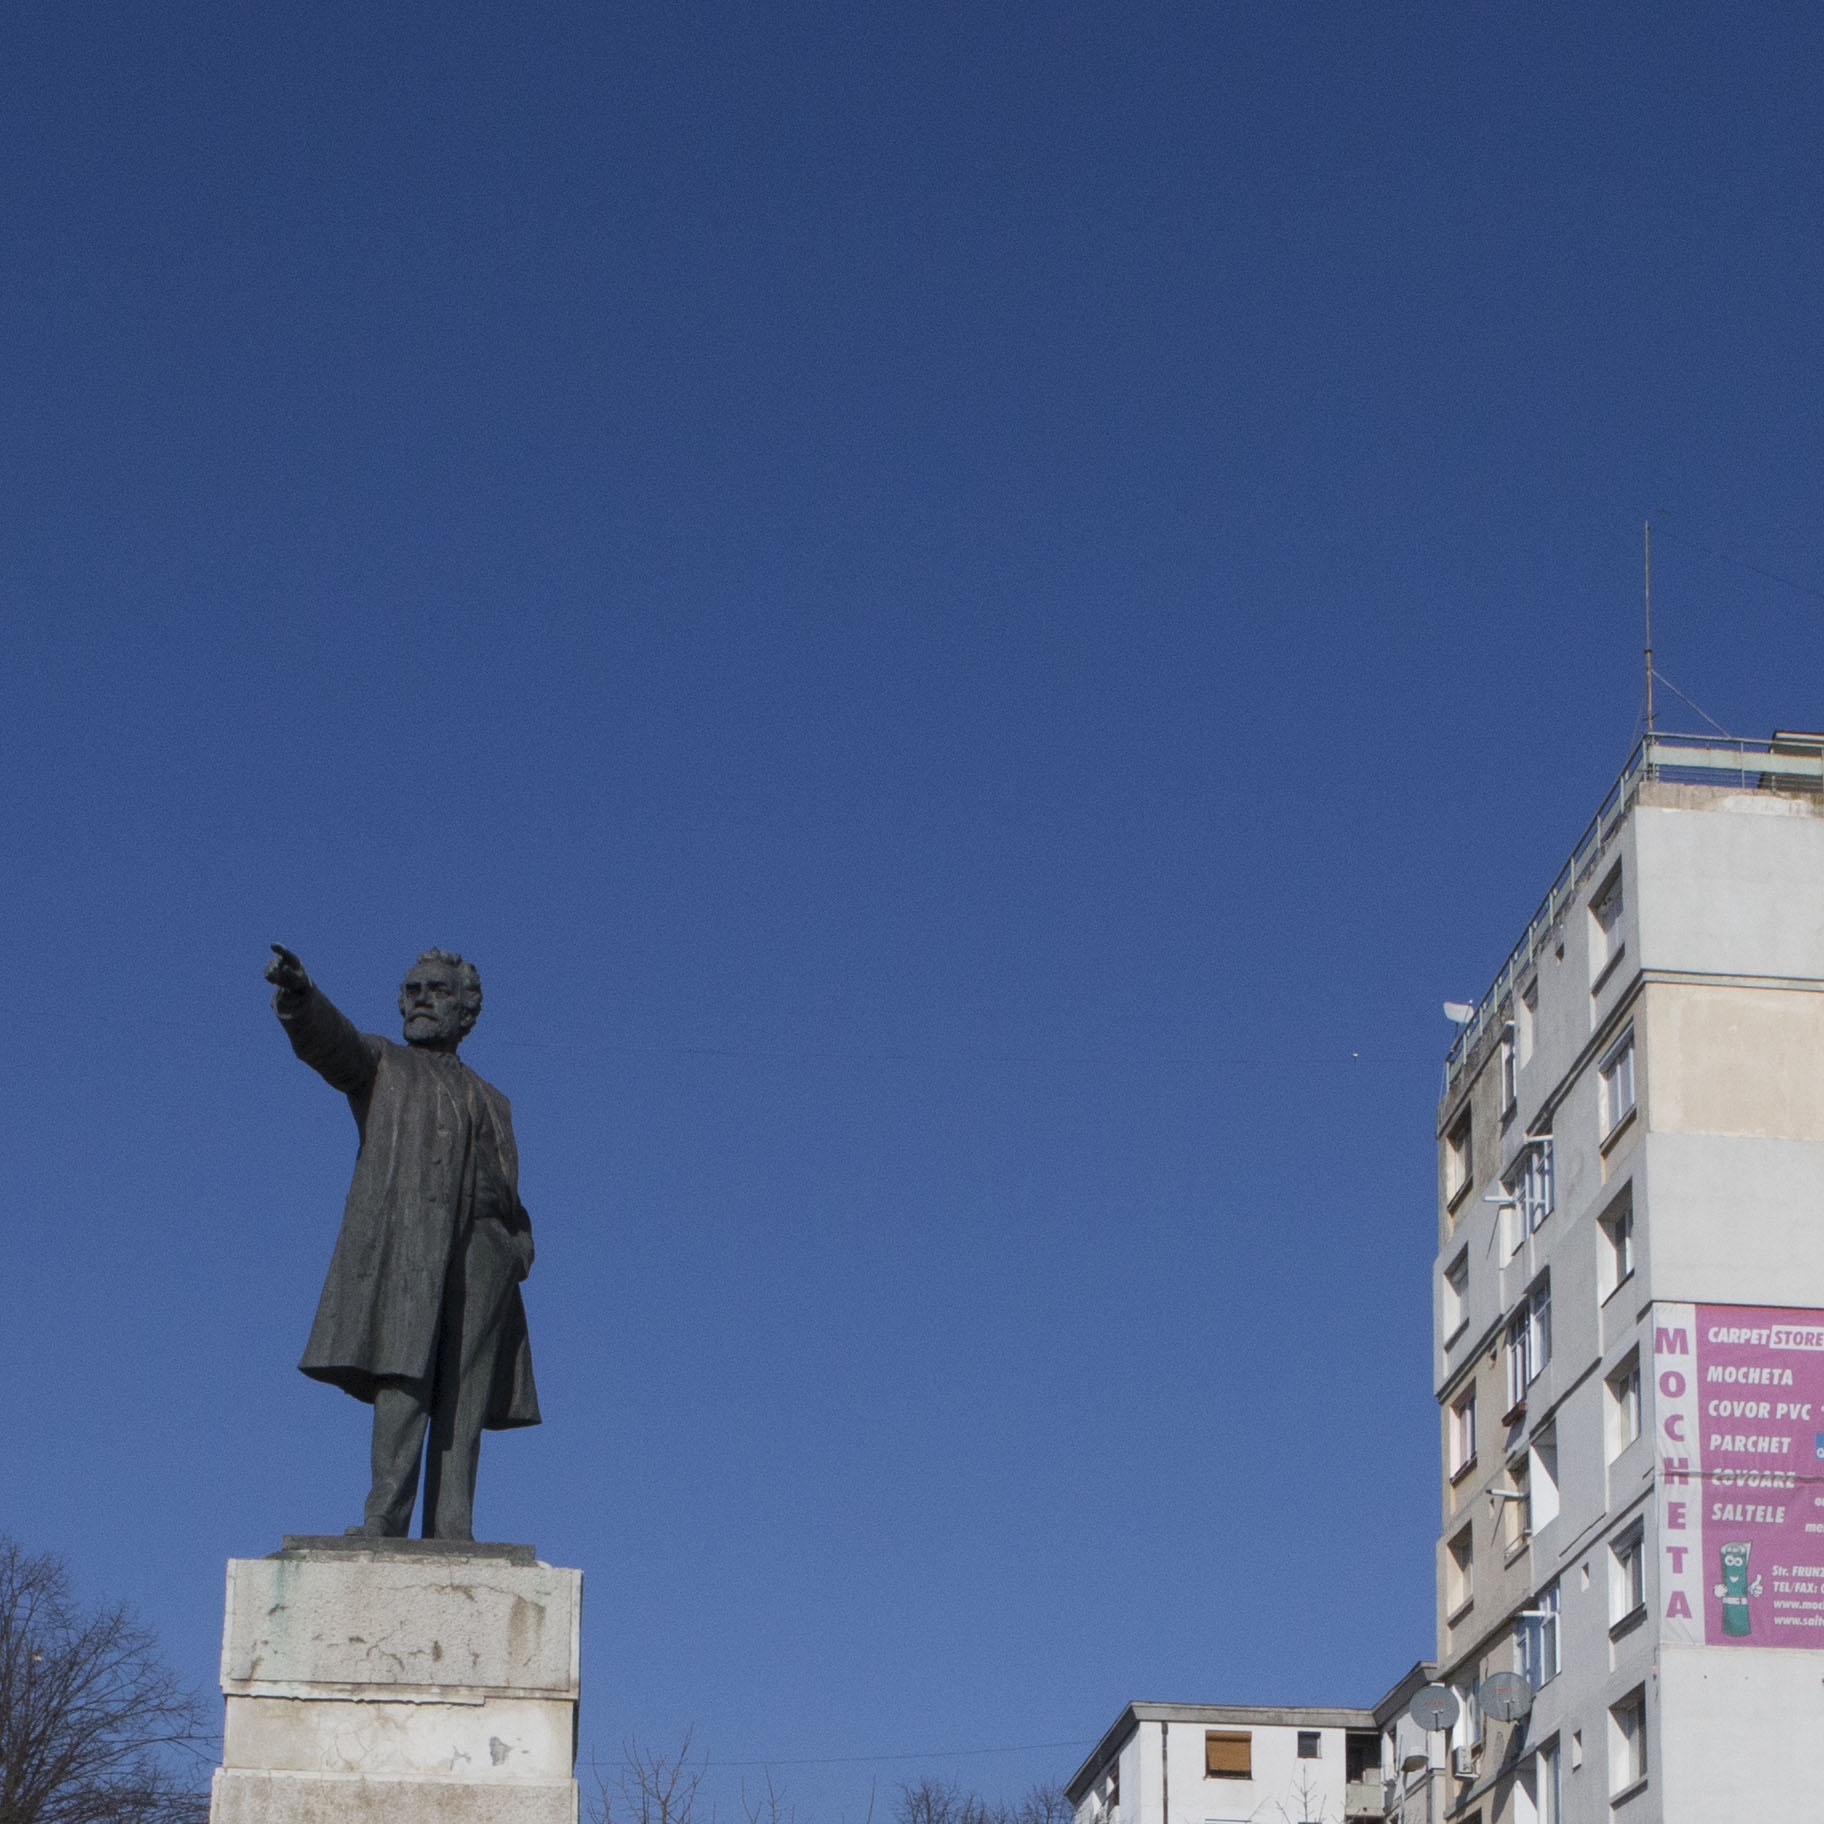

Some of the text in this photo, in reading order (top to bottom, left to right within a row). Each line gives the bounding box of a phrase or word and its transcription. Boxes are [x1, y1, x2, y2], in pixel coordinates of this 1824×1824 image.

[1708, 1327, 1770, 1345] CARPET
[1773, 1330, 1824, 1347] STORE
[1707, 1366, 1793, 1386] MOCHETA
[1708, 1400, 1811, 1421] COVOR PVC
[1709, 1434, 1791, 1454] PARCHET
[1654, 1327, 1692, 1619] MOCHETA
[1711, 1468, 1796, 1488] COVOARE
[1711, 1503, 1785, 1524] SALTELE
[1772, 1565, 1789, 1576] Str.
[1773, 1581, 1818, 1594] TEL/FAX:
